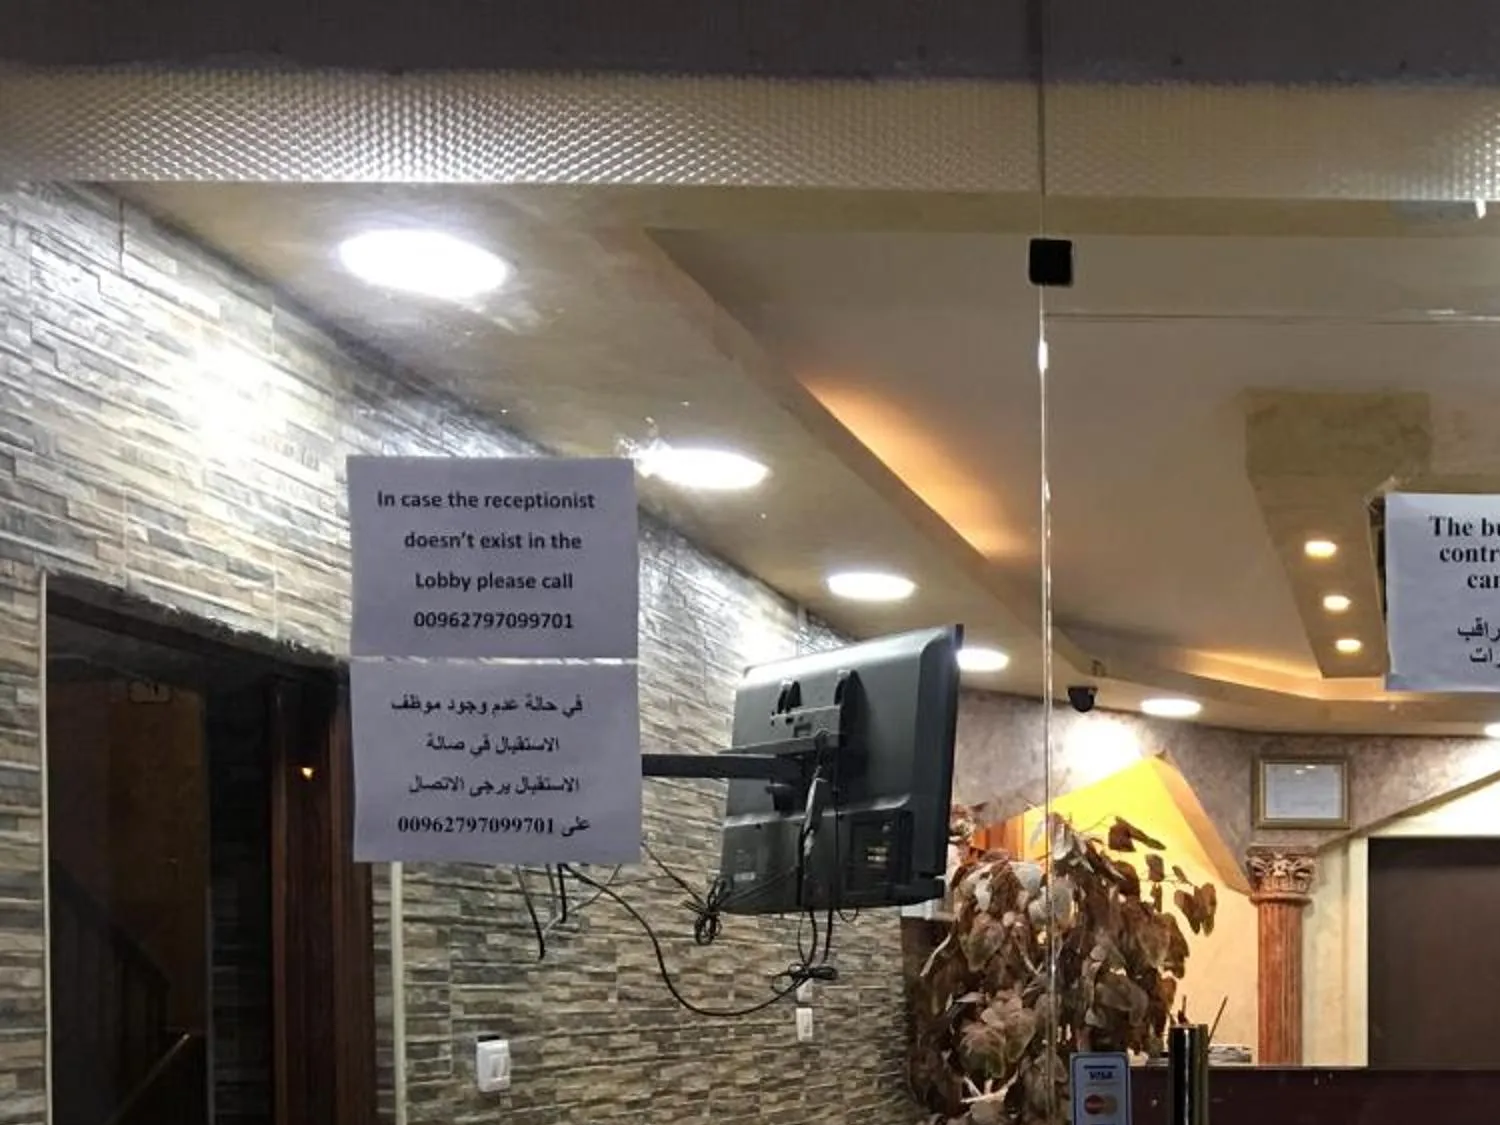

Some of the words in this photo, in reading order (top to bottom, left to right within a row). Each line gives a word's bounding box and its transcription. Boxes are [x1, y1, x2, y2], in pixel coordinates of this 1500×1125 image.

[377, 490, 396, 508] In
[399, 494, 443, 509] case
[447, 491, 479, 509] the
[483, 492, 595, 513] receptionist
[1429, 516, 1474, 538] The
[479, 532, 523, 550] exist
[528, 531, 546, 550] in
[550, 531, 582, 550] the
[415, 571, 472, 593] Lobby
[476, 571, 537, 593] please
[541, 572, 573, 590] call
[413, 611, 574, 630] 00962797099701
[391, 694, 442, 715] موظف
[447, 699, 488, 716] وجود
[491, 699, 519, 718] عدم
[524, 693, 559, 712] حالة
[425, 732, 466, 751] صالة
[495, 735, 560, 756] الاستقبال
[408, 774, 465, 794] الاتصال
[514, 775, 580, 796] الاستقبال
[397, 816, 554, 835] 00962797099701
[560, 815, 591, 838] على
